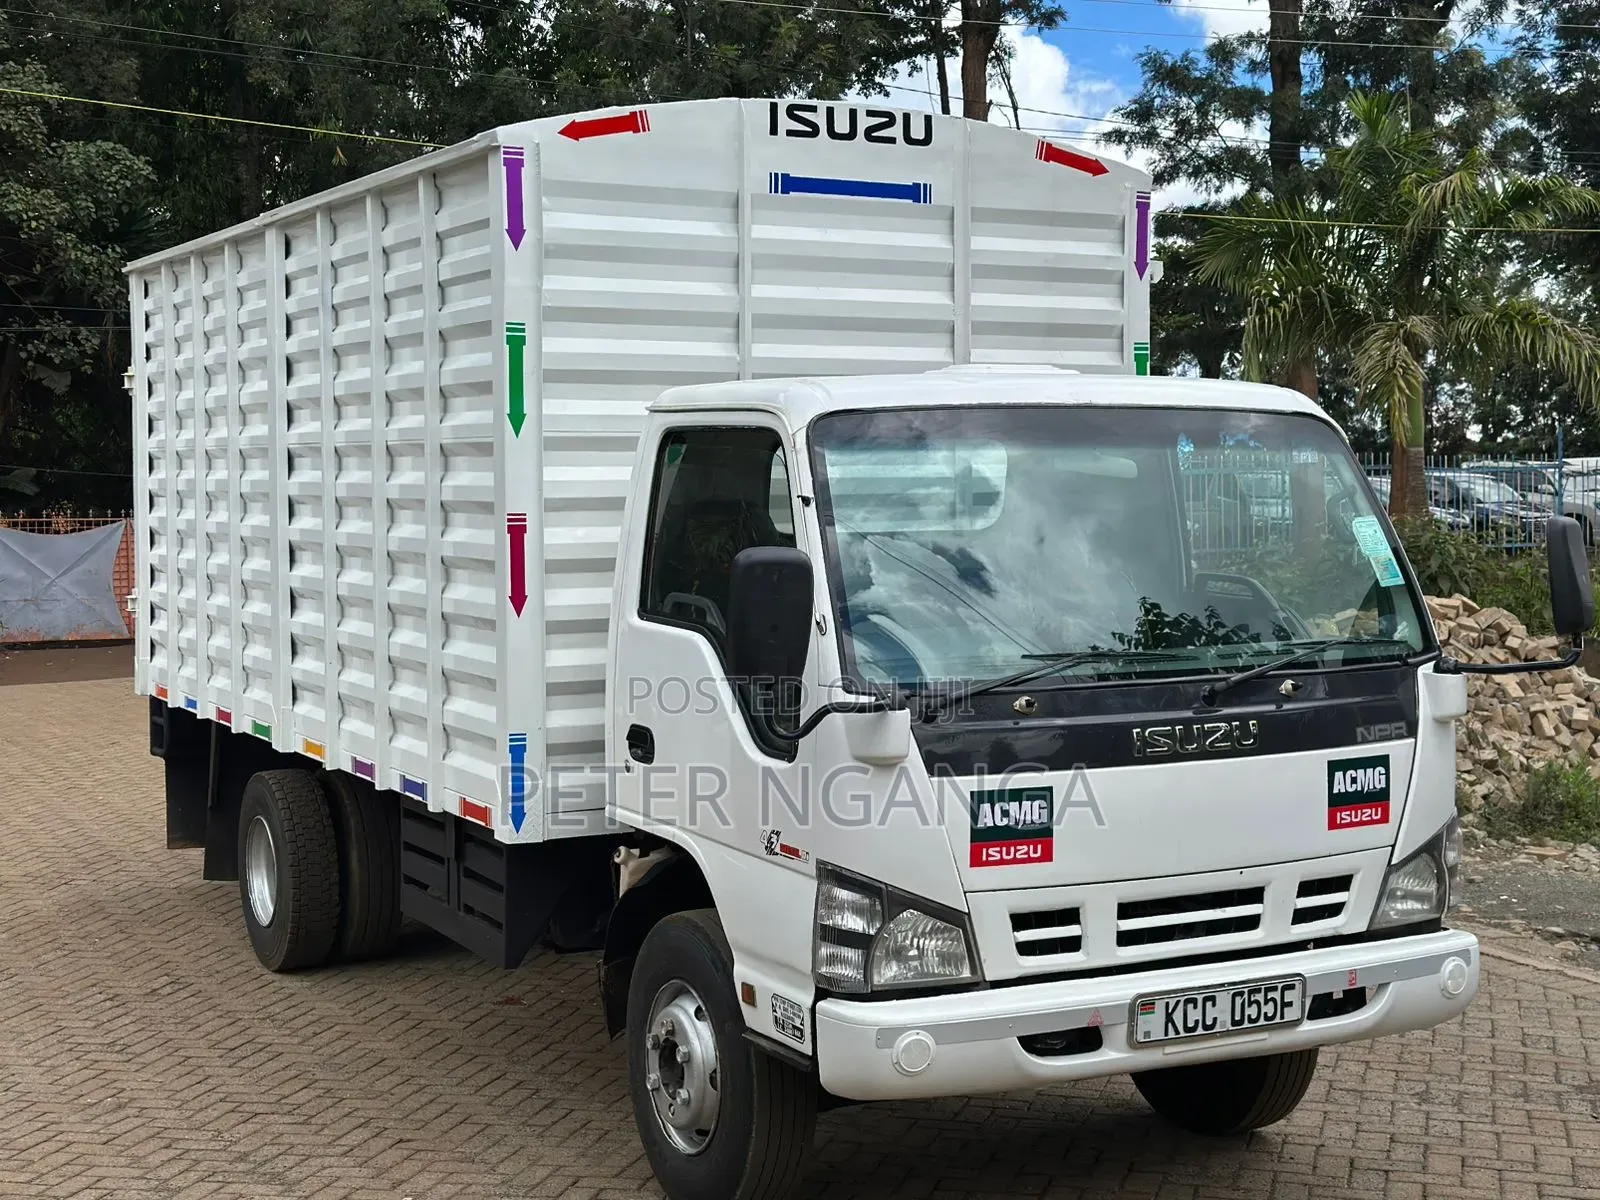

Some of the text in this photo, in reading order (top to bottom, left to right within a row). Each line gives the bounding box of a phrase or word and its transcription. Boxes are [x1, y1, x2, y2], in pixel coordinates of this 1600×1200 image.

[769, 101, 933, 147] ISUZU
[1132, 719, 1260, 757] ISUZU
[1356, 721, 1409, 742] NPR
[1333, 766, 1386, 795] ACMG
[977, 799, 1048, 829] ACMG
[1336, 807, 1382, 824] ISUZU
[982, 844, 1041, 861] ISUZU
[1164, 983, 1296, 1037] KCC 055F
